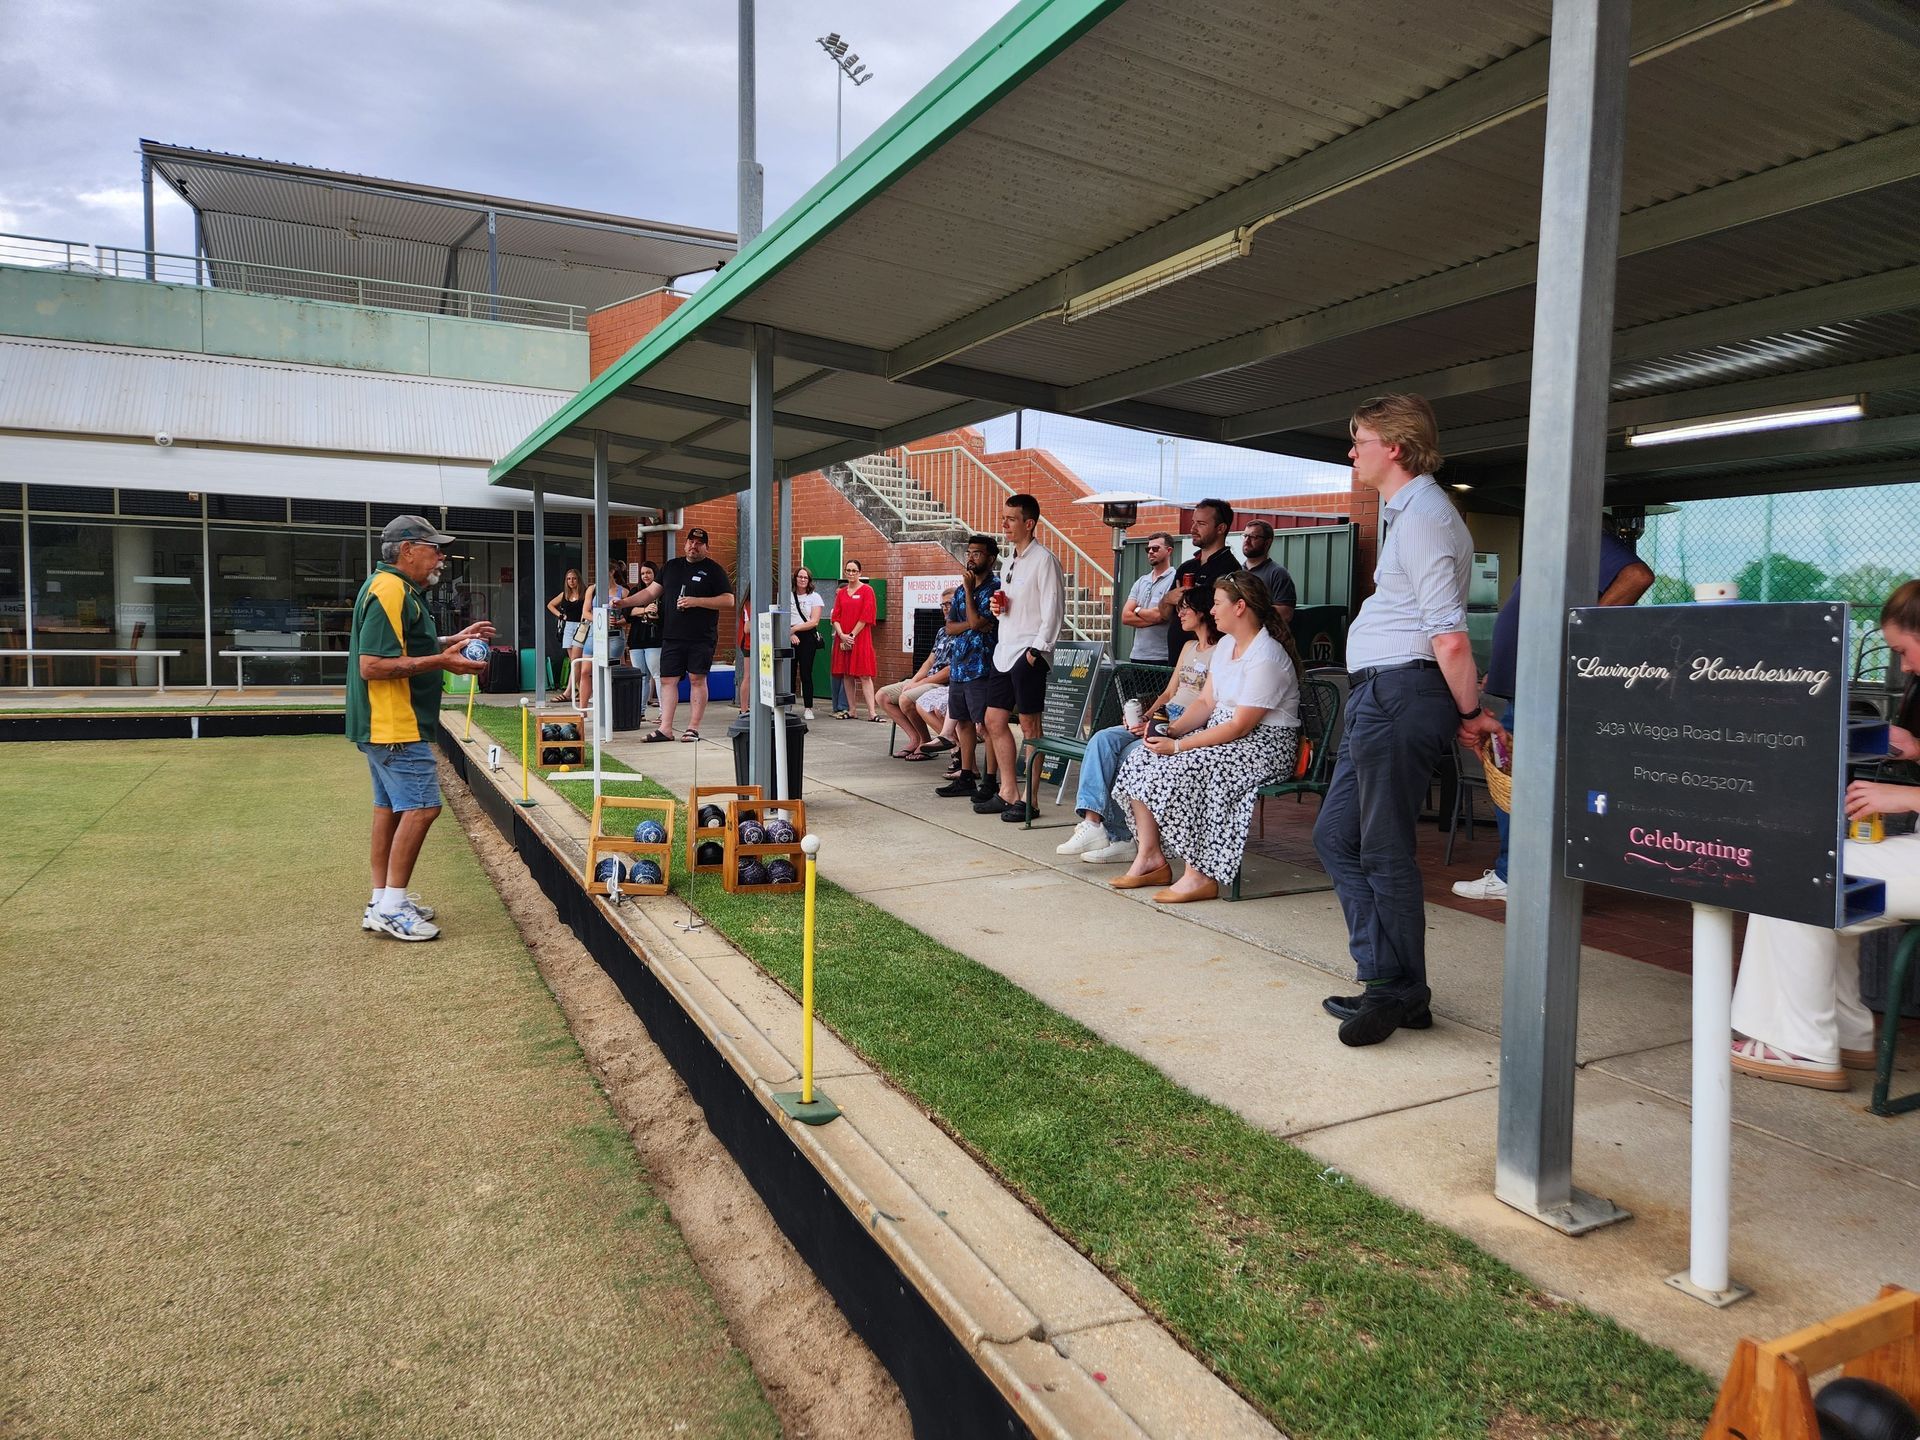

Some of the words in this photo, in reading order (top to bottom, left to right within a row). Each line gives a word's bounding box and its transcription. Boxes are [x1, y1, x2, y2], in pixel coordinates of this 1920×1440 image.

[907, 580, 936, 591] MEMBERS
[937, 580, 942, 591] &
[917, 593, 939, 604] PLEASE
[1312, 643, 1332, 661] VB
[1576, 656, 1671, 689] Lavington
[1689, 656, 1831, 695] Hairdressing
[1595, 721, 1625, 736] 343a
[1628, 721, 1679, 741] Wagga
[1682, 724, 1721, 741] Road
[1725, 727, 1806, 749] Lavington
[490, 747, 498, 763] 1
[1681, 771, 1754, 793] 60252071
[1629, 826, 1752, 868] Celebrating
